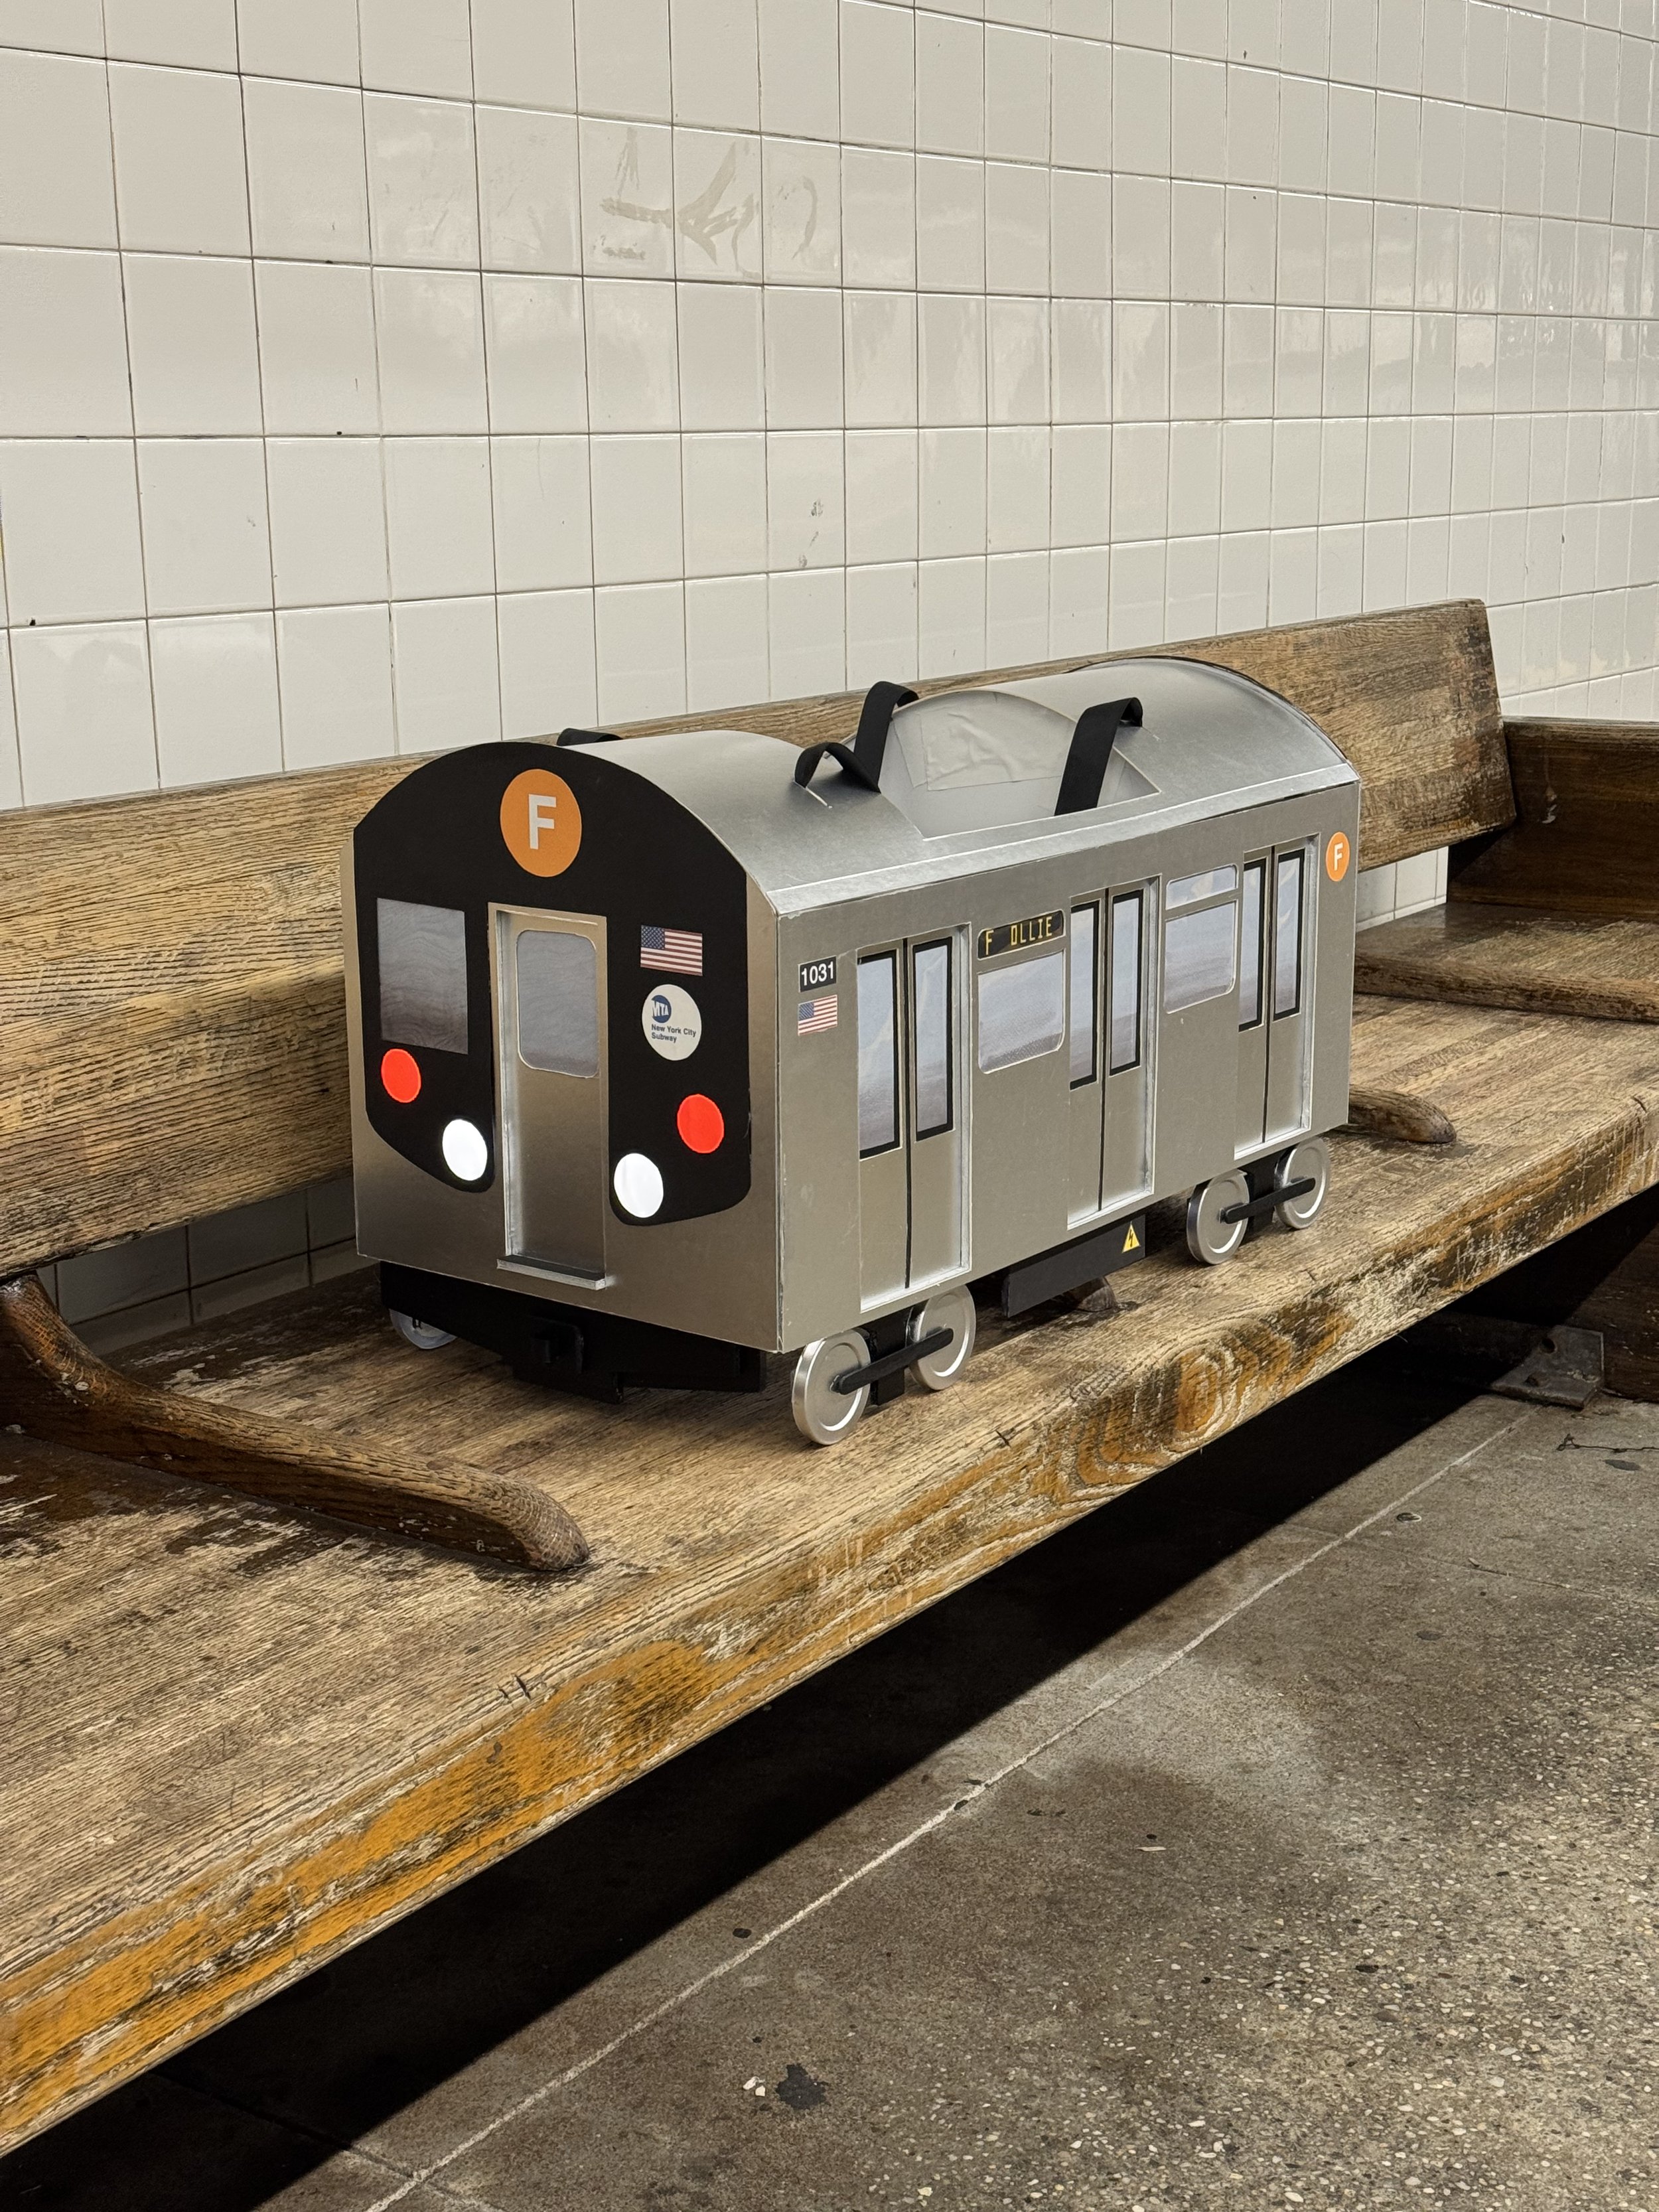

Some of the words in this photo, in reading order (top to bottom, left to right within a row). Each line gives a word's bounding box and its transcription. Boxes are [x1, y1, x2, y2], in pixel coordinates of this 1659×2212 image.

[528, 793, 557, 850] F
[1334, 842, 1343, 871] F
[985, 929, 994, 956] F
[1011, 917, 1052, 946] OLLIE
[801, 960, 833, 986] 1031
[651, 999, 670, 1017] MTA
[651, 1023, 666, 1032] New
[667, 1025, 682, 1034] York
[683, 1027, 697, 1038] City
[651, 1031, 677, 1043] Subway
